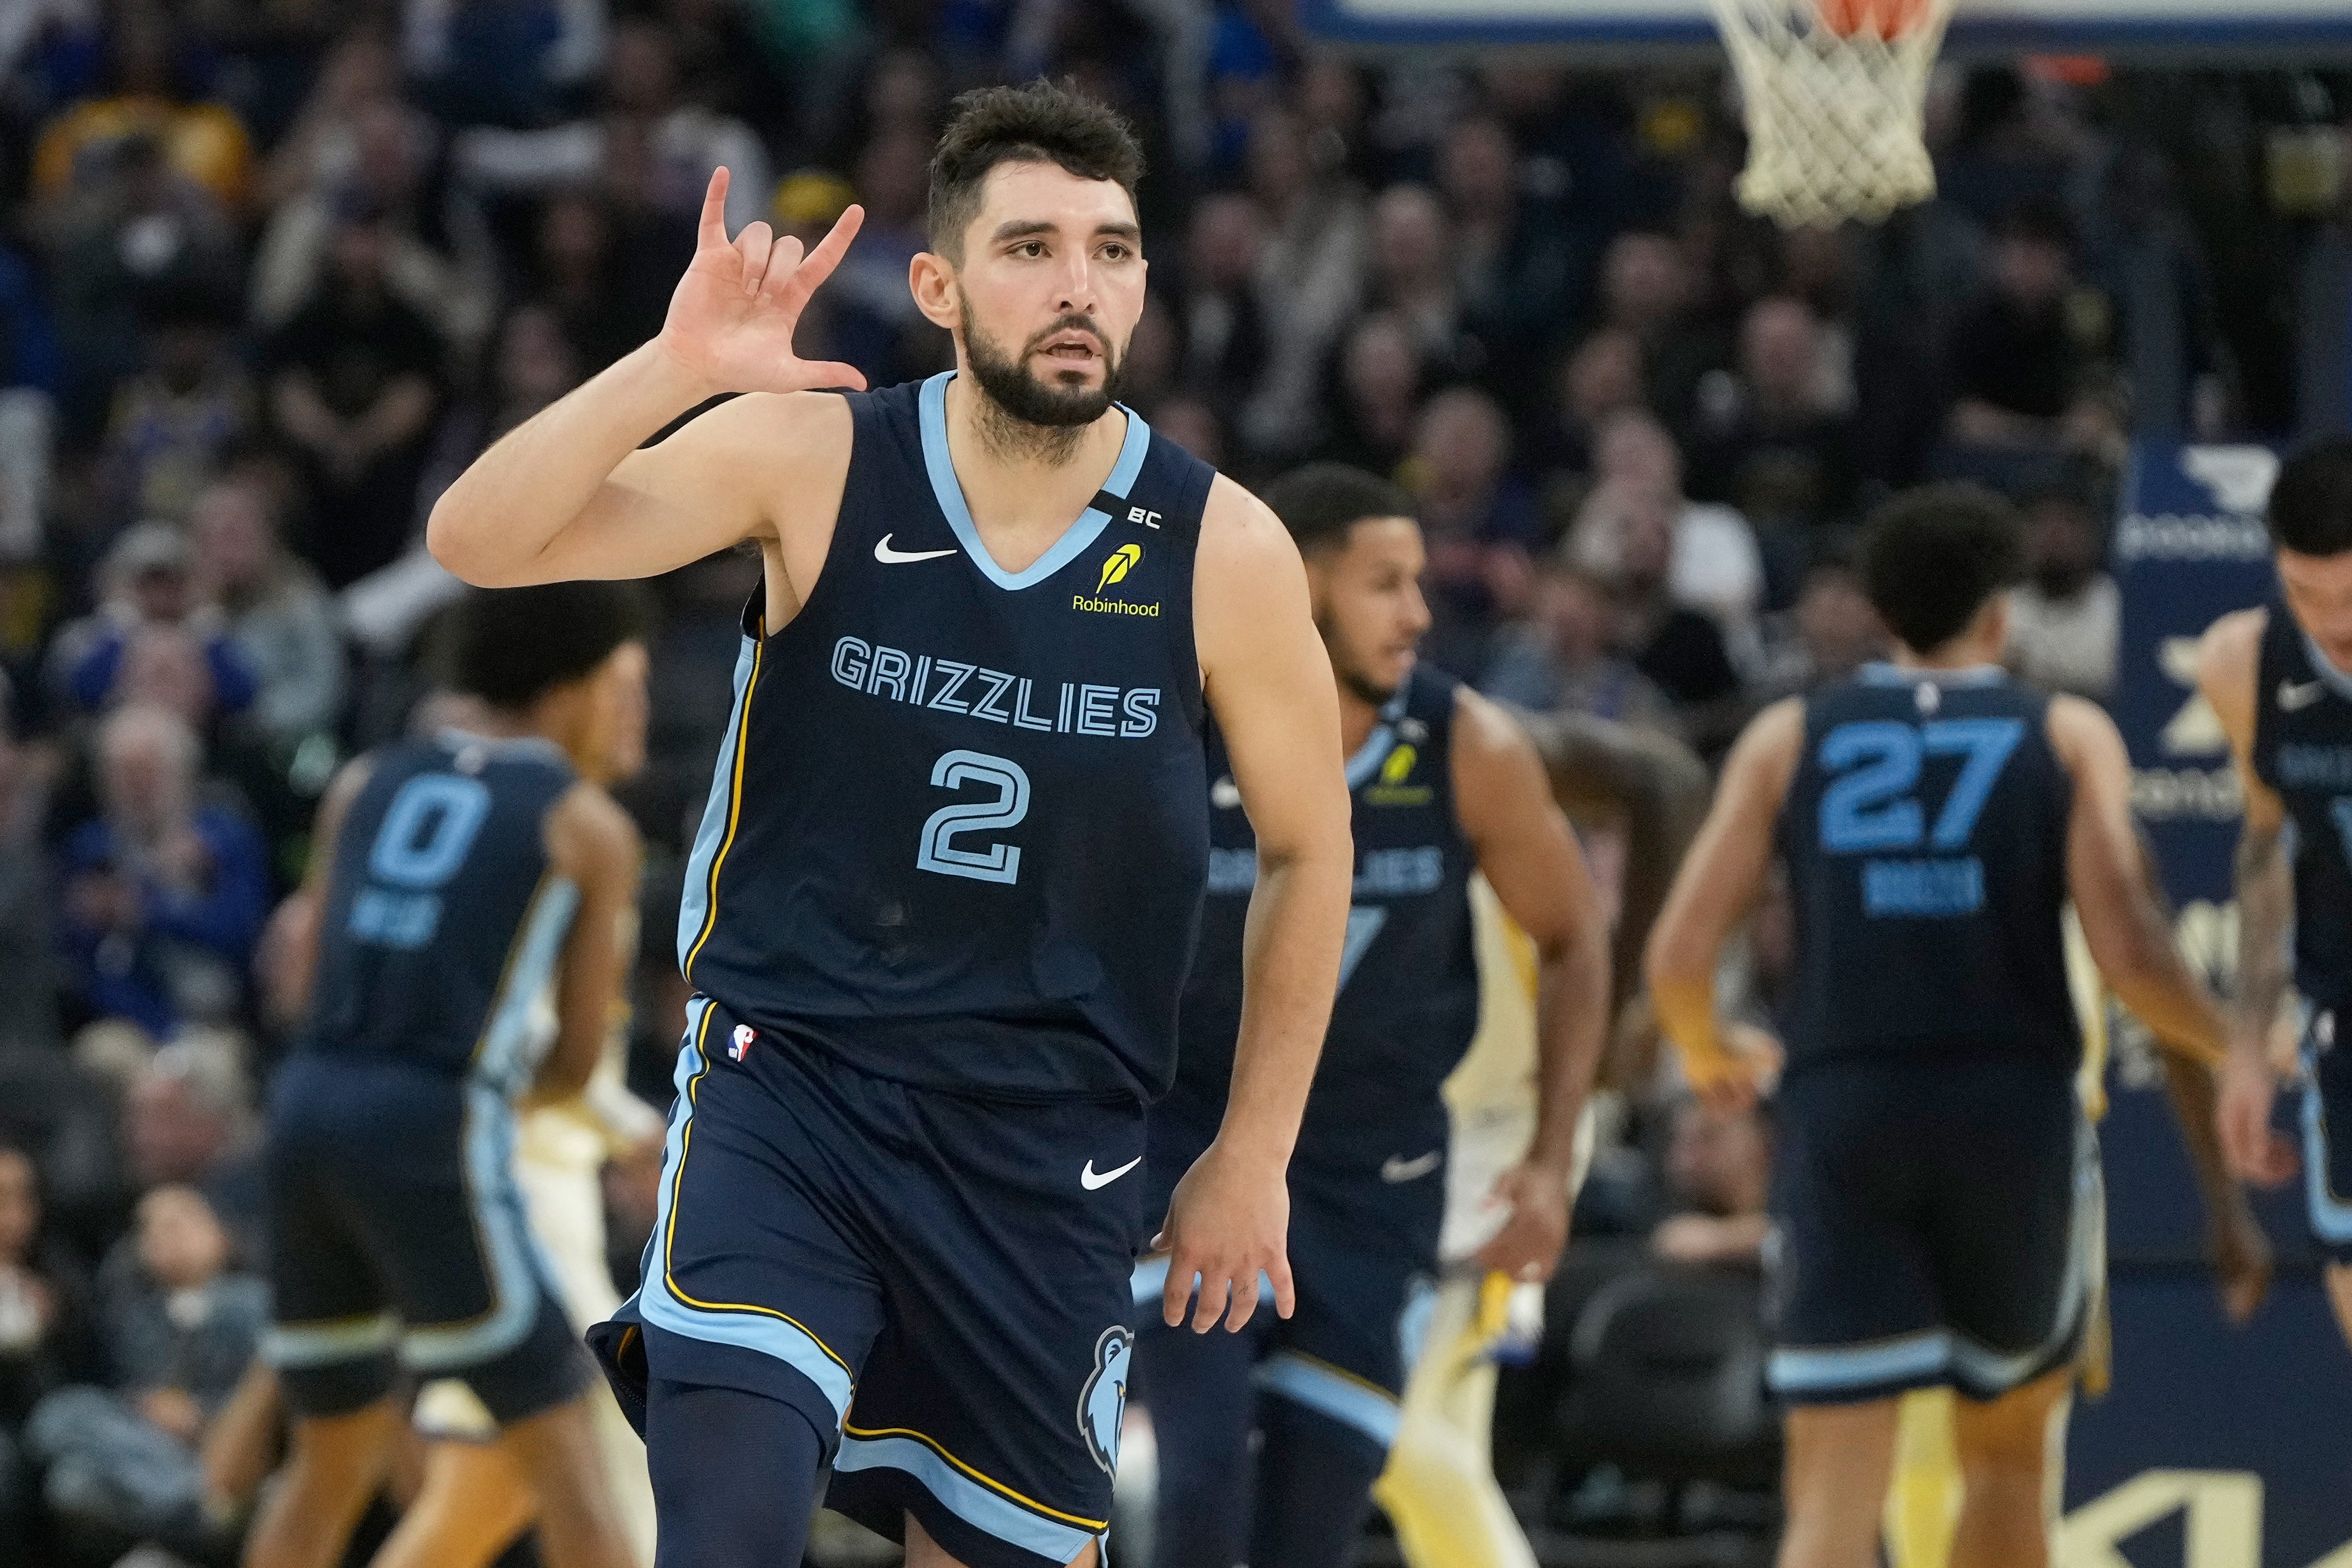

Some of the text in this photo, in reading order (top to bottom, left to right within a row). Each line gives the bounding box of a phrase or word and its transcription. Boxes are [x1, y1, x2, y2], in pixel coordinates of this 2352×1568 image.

[1127, 506, 1162, 530] BC
[1072, 595, 1159, 617] Robinhood
[830, 635, 1161, 738] GRIZZLIES
[370, 773, 490, 888] 0
[916, 749, 1031, 885] 2
[1819, 717, 2025, 853] 27
